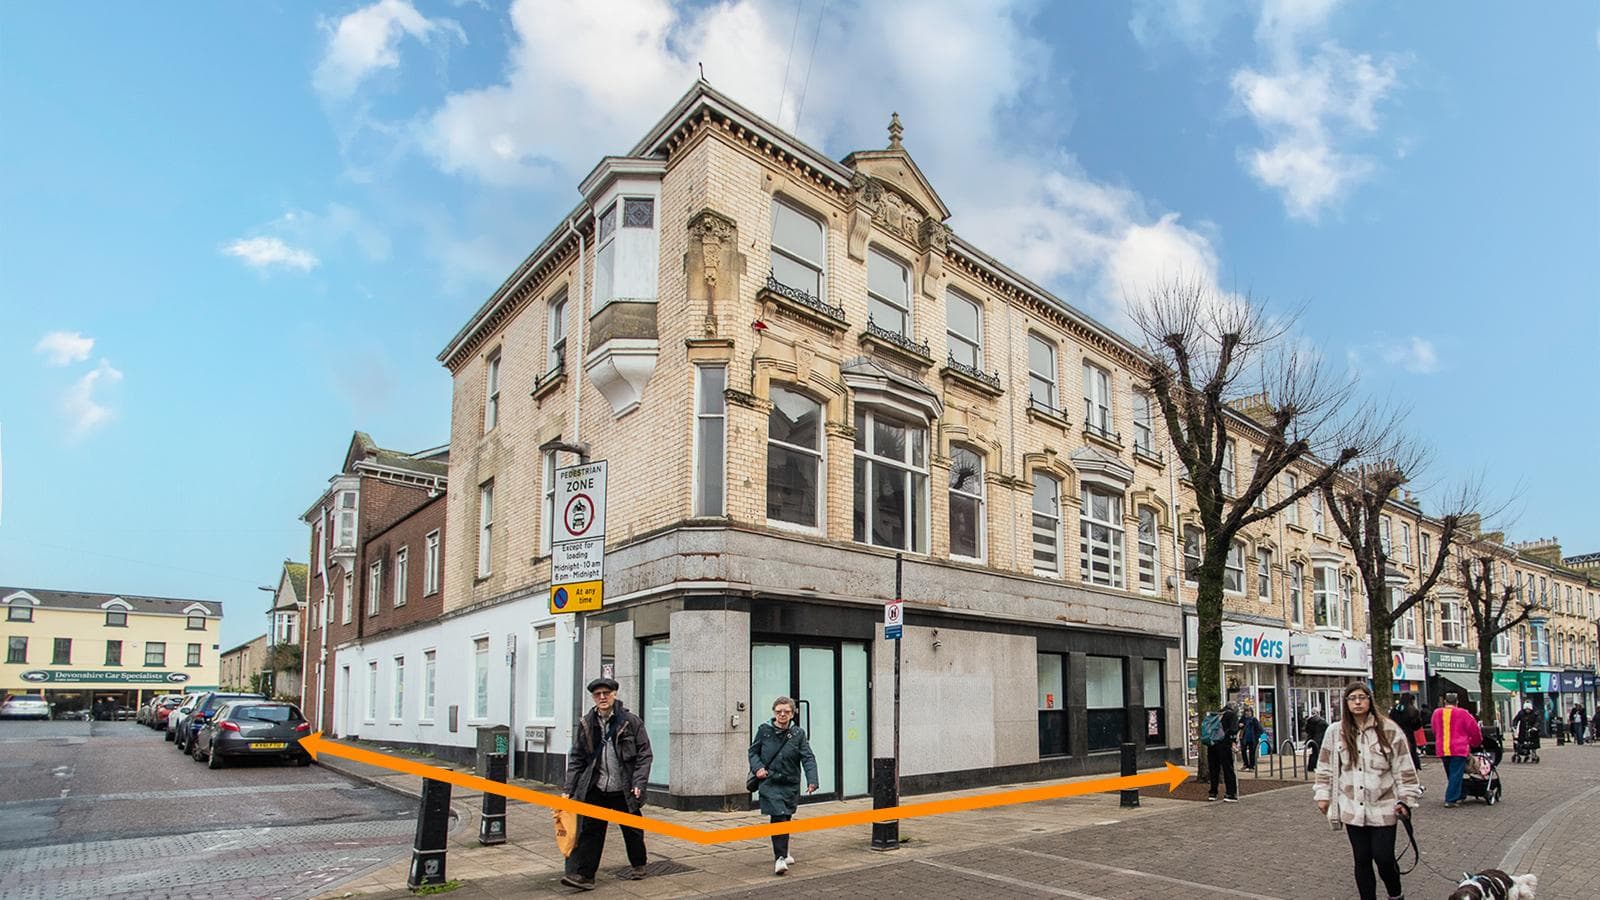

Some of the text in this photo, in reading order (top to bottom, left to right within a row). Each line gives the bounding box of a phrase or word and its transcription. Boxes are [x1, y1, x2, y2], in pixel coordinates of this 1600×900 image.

[560, 466, 602, 479] PEDESTRIAN
[566, 478, 594, 492] ZONE
[562, 540, 594, 552] Except for
[566, 551, 588, 560] loading
[554, 562, 580, 572] Midnight
[573, 569, 599, 578] Midnight
[585, 588, 595, 596] any
[1233, 632, 1283, 659] savers
[55, 671, 104, 679] Devonshire
[105, 671, 120, 680] Car
[121, 672, 163, 681] Specialists
